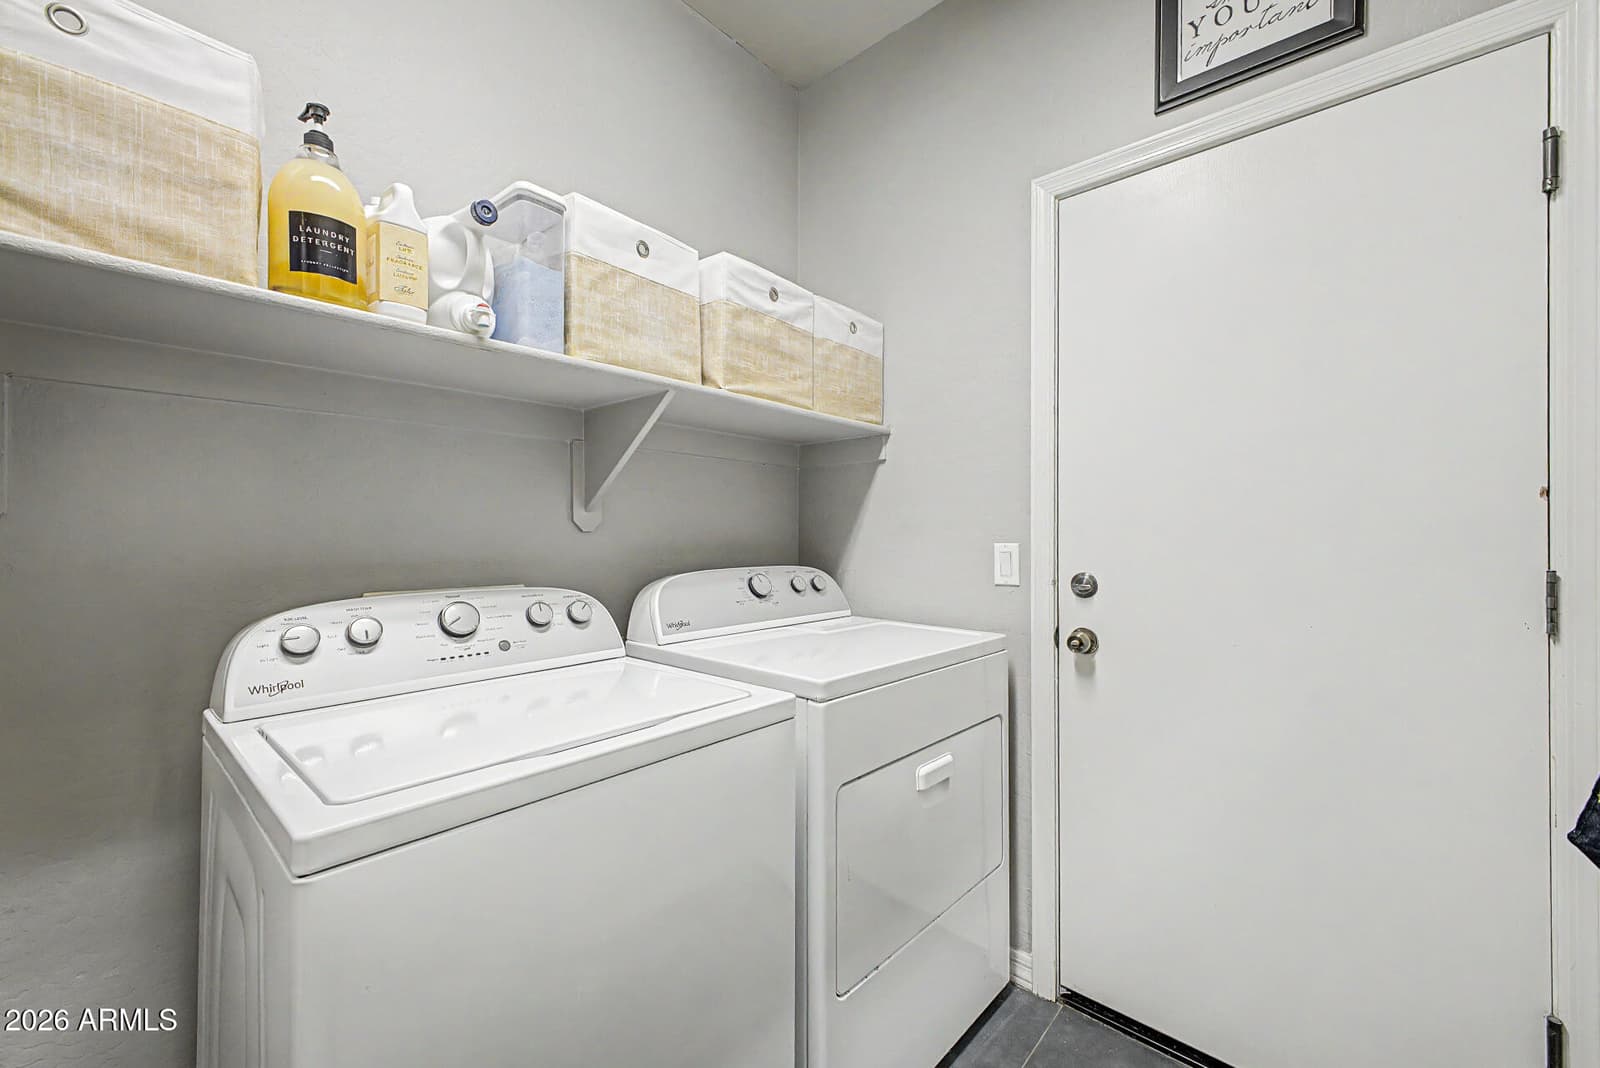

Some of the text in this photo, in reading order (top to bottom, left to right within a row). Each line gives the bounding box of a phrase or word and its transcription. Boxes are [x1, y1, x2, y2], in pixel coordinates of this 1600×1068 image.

[299, 224, 350, 243] LAUNDRY
[292, 235, 355, 257] DETERGENT
[247, 679, 305, 697] Whirlpool
